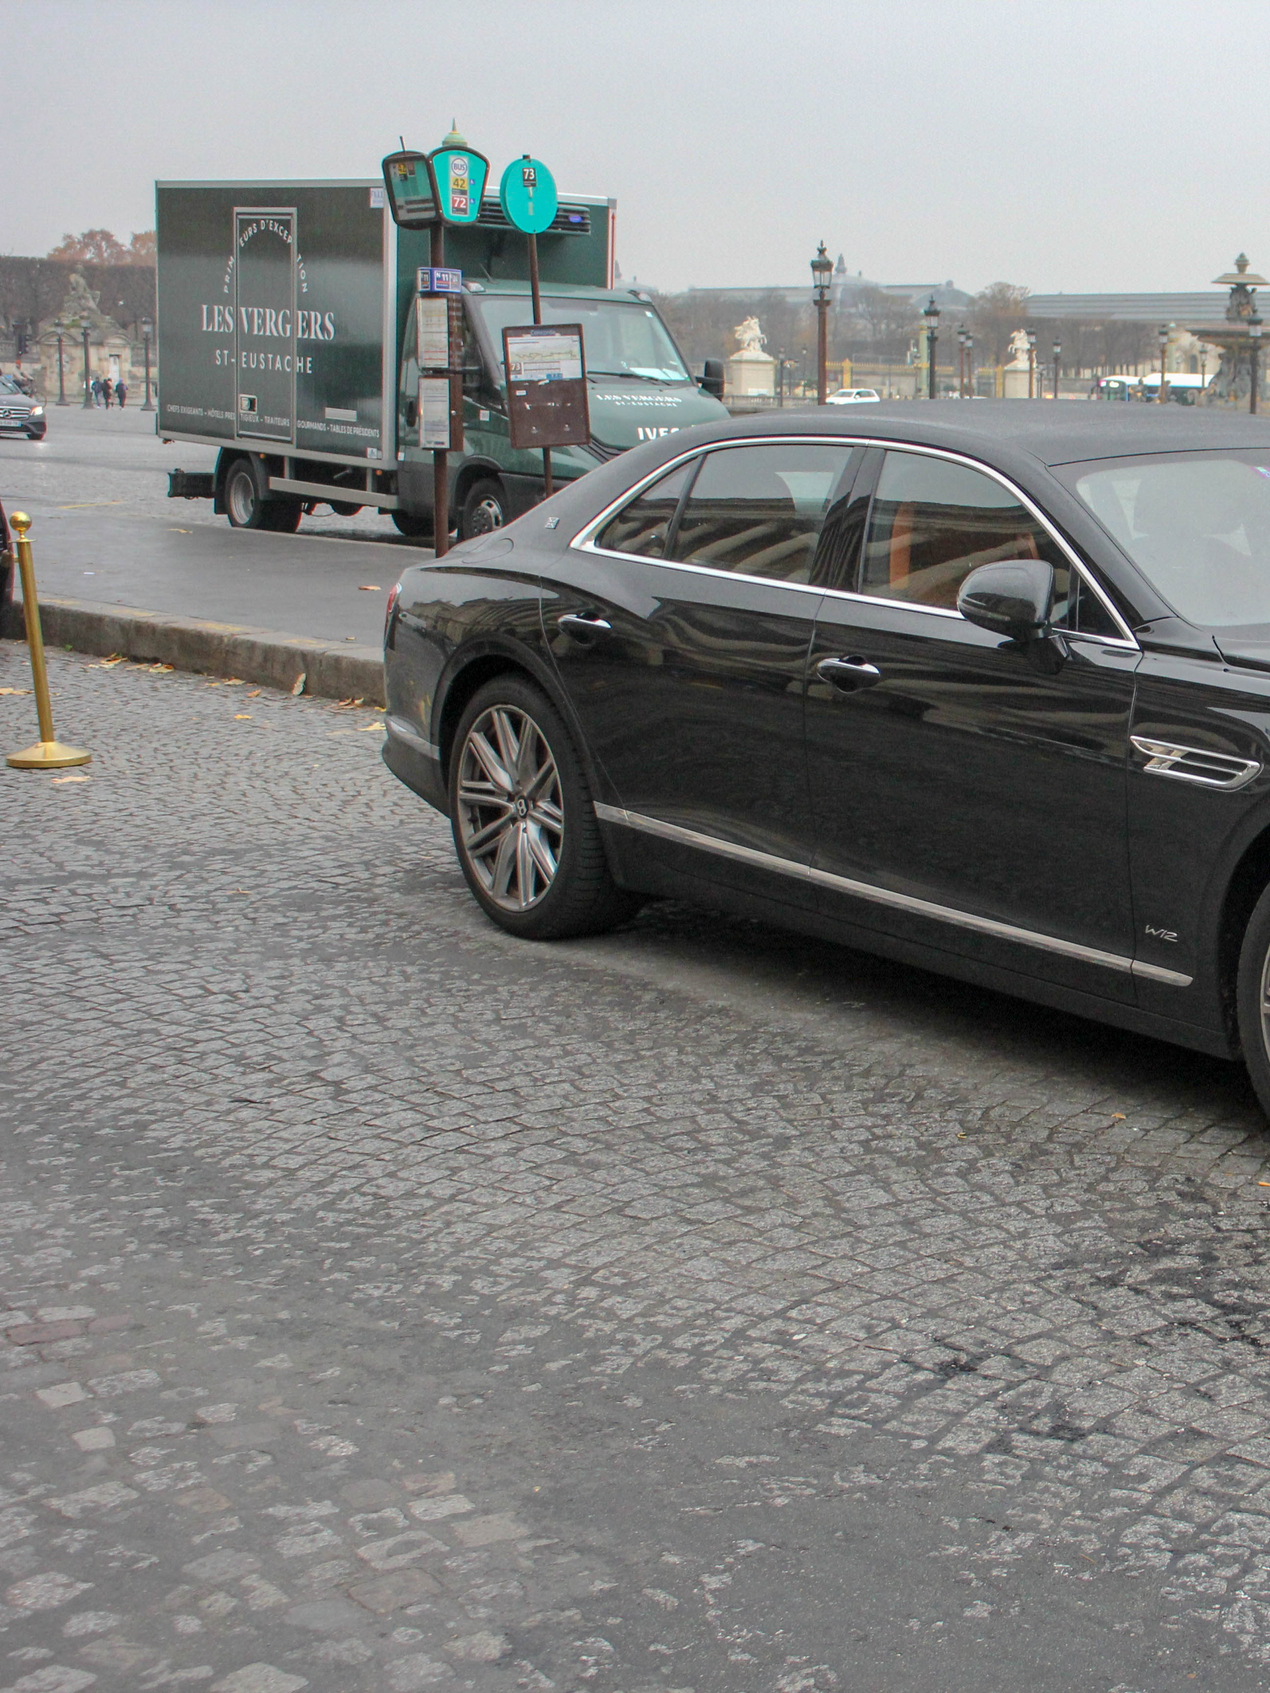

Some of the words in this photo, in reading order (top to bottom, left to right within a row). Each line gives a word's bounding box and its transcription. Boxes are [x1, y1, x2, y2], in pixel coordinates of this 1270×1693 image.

[453, 162, 466, 172] BUS
[523, 168, 535, 180] 73
[453, 179, 466, 188] 42
[453, 197, 467, 208] 72
[442, 273, 449, 281] 11
[201, 304, 234, 333] LES
[239, 306, 335, 341] VERGERS
[510, 363, 521, 371] 73
[1145, 924, 1178, 942] W12
